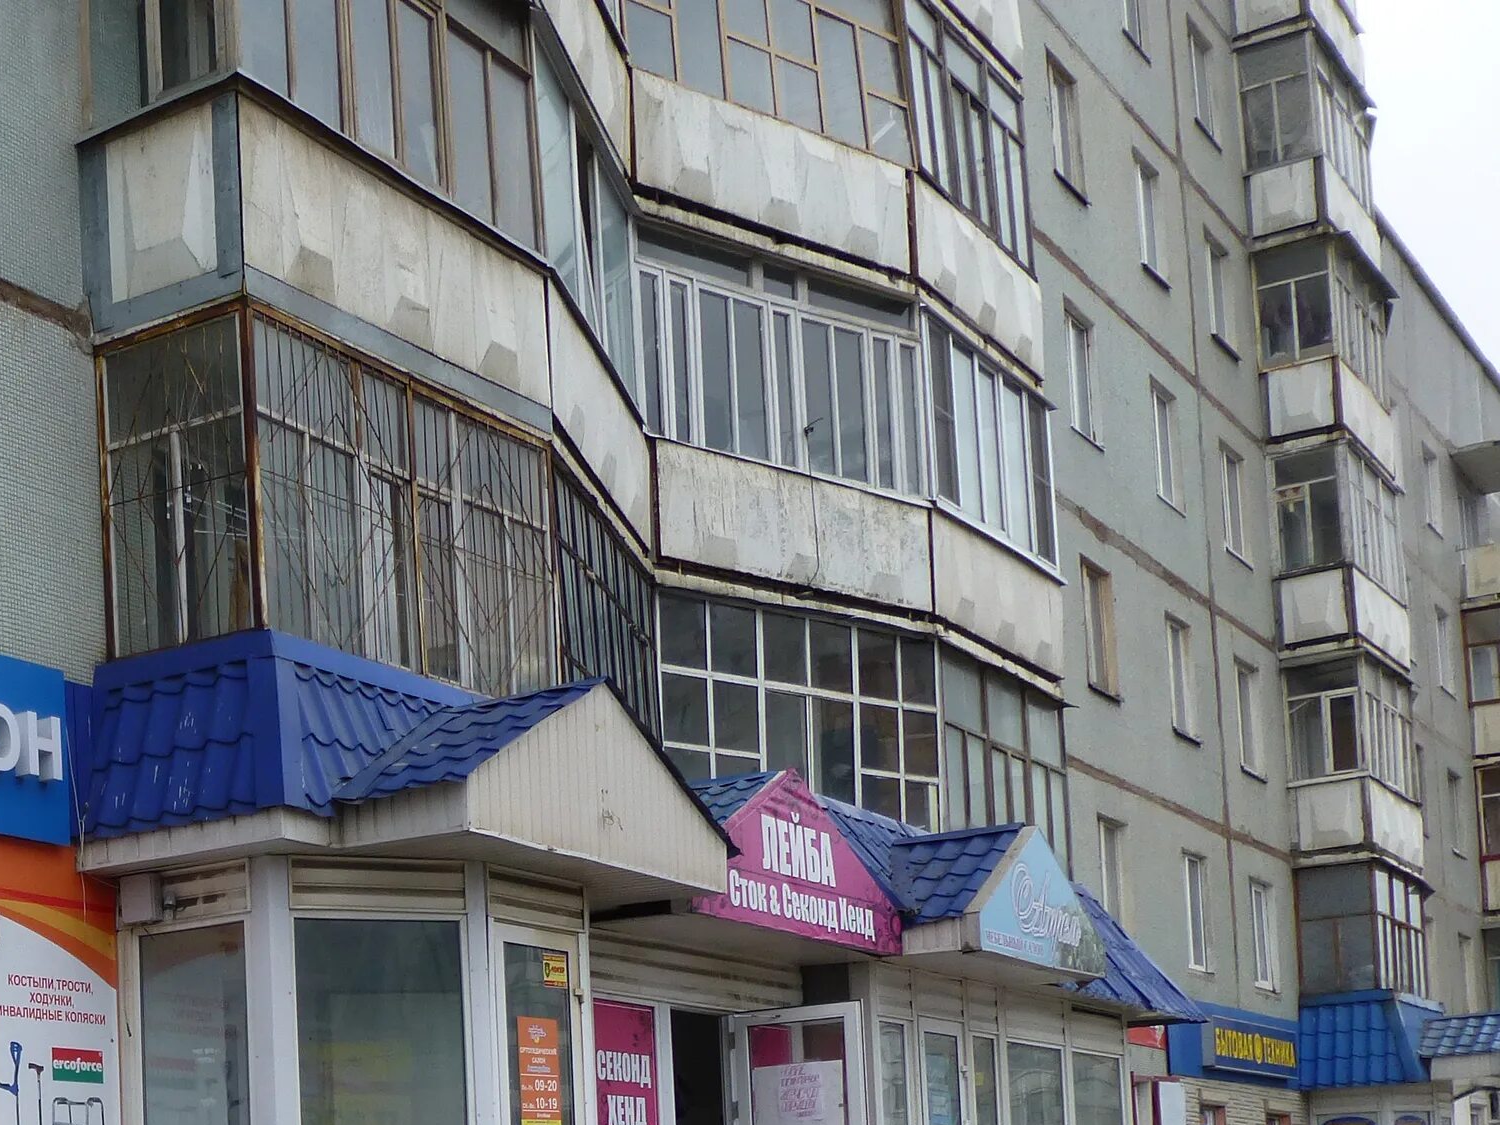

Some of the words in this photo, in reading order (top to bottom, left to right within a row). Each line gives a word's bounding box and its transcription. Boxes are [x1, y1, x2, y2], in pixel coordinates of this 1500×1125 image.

[761, 811, 837, 888] ЛЕЙБА
[729, 869, 768, 912] Сток
[770, 885, 781, 916] &
[782, 883, 839, 933] Секонд
[838, 896, 876, 942] Хенд
[29, 992, 75, 1008] ХОДУНКИ,
[65, 1010, 106, 1026] КОЛЯСКИ
[1215, 1027, 1254, 1061] БЫТОВАЯ
[1263, 1036, 1297, 1069] ТЕХНИКА
[52, 1056, 103, 1073] ergoforce
[597, 1049, 652, 1089] СЕКОНД
[534, 1079, 558, 1092] 09-20
[535, 1097, 558, 1109] 10-19
